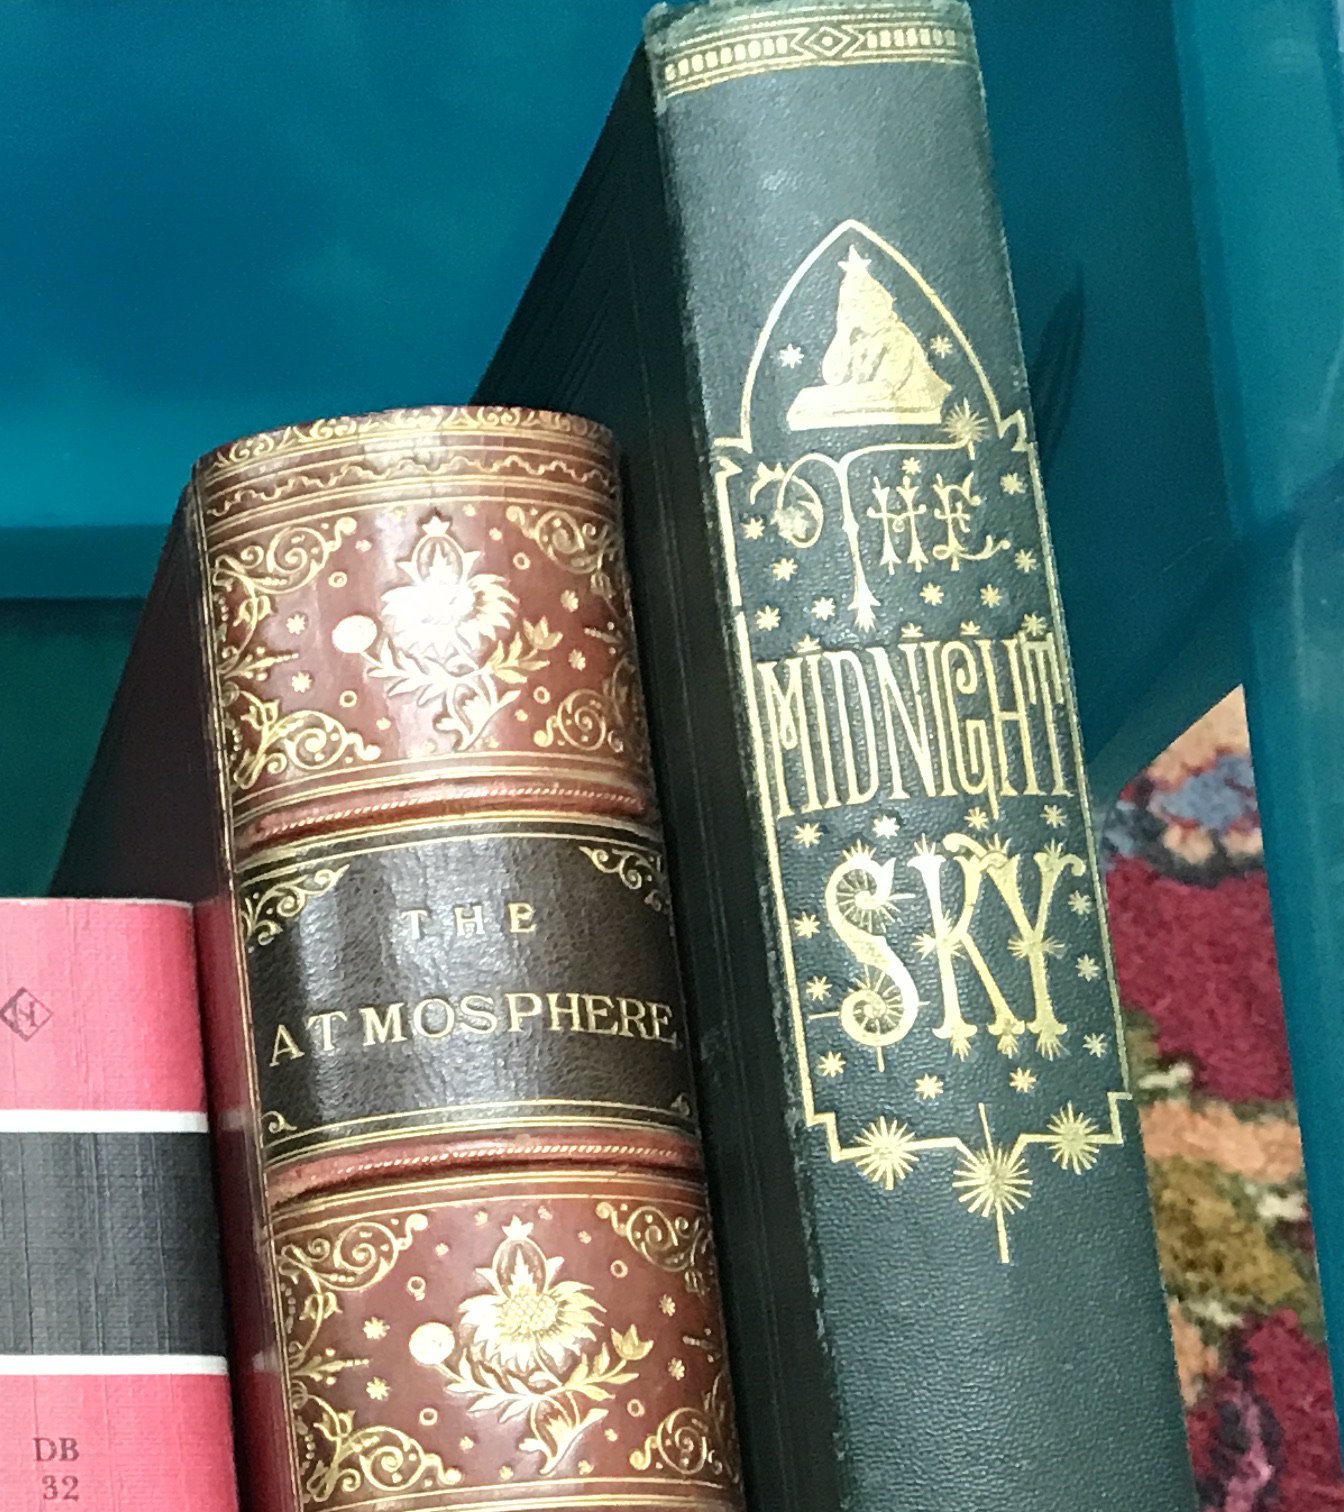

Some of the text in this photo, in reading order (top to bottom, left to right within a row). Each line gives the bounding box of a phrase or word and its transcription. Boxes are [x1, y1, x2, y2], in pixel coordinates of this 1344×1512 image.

[752, 432, 1010, 632] THE
[756, 630, 1074, 818] MIDNIGHT
[400, 903, 538, 940] THE
[818, 834, 1086, 1060] SKY
[33, 1436, 80, 1463] DB
[41, 1475, 80, 1502] 32
